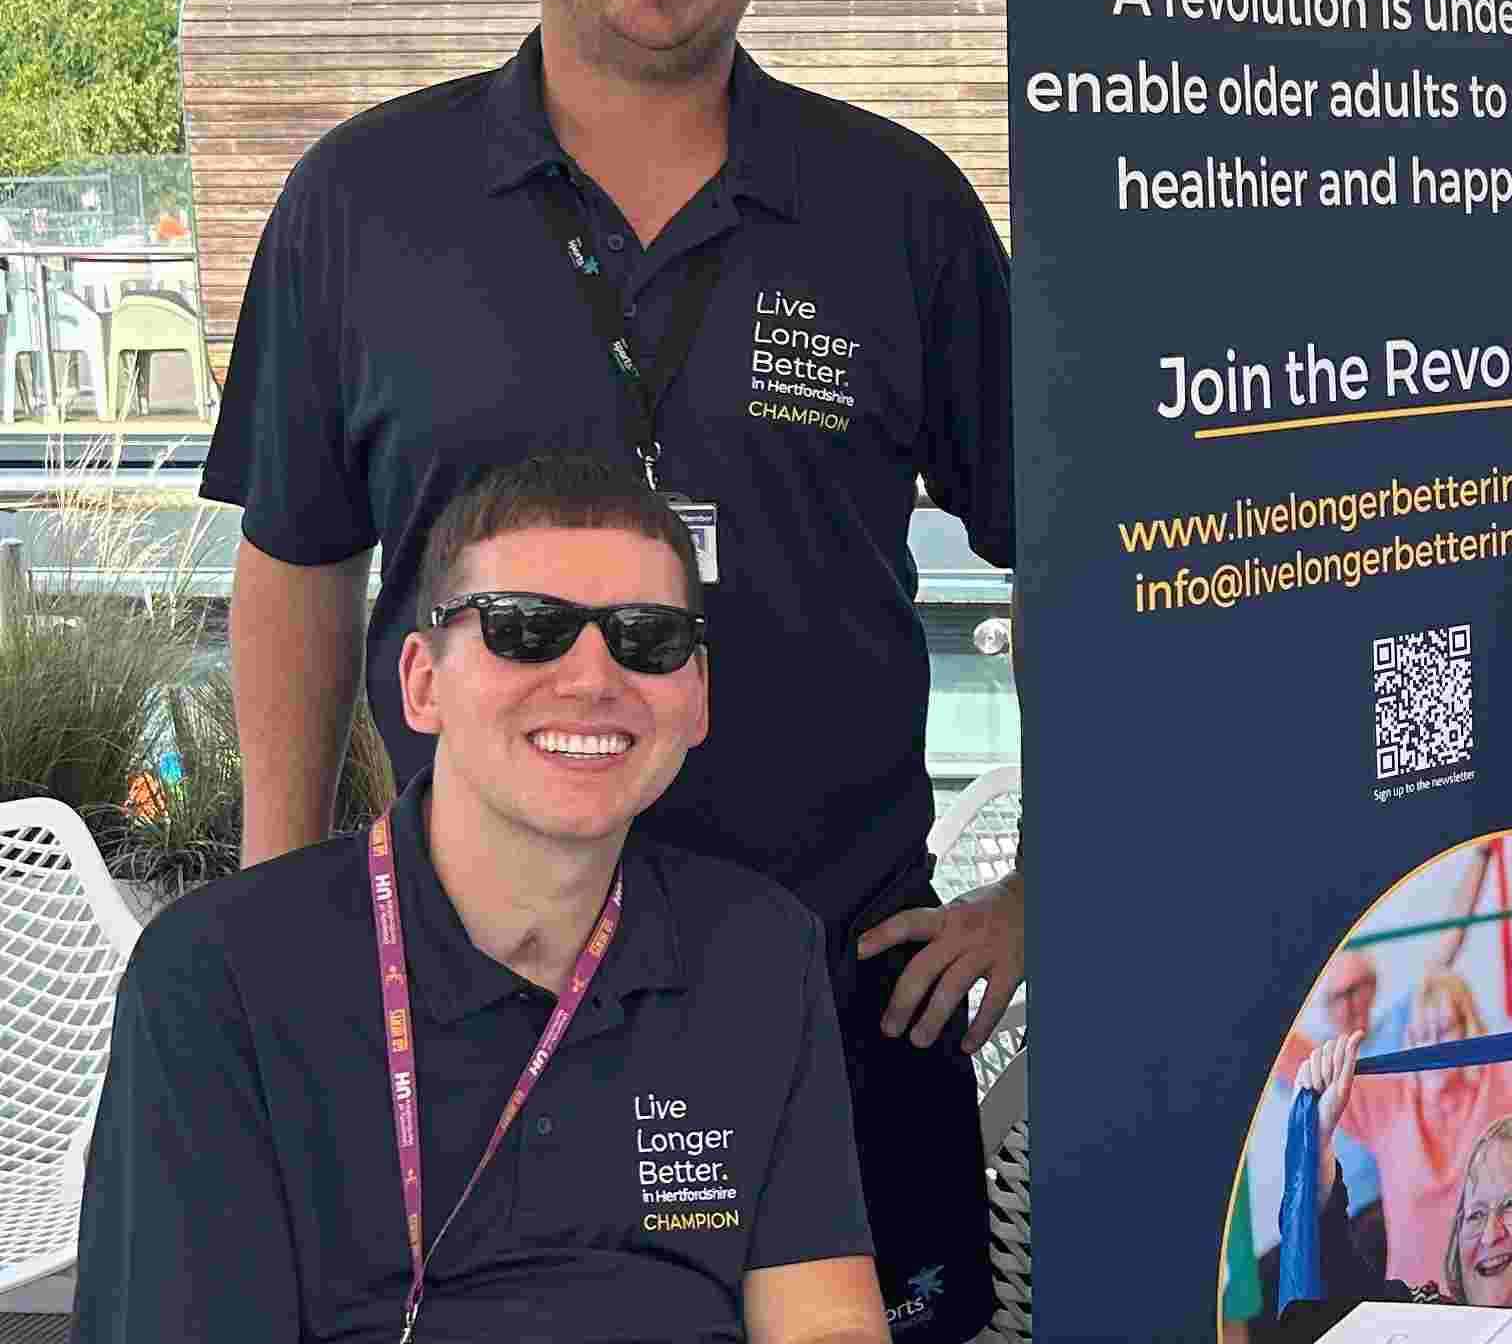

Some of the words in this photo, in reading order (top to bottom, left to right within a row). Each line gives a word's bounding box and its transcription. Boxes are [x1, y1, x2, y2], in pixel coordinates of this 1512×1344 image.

[1026, 60, 1208, 114] enable
[1218, 64, 1318, 118] older
[1329, 69, 1459, 120] adults
[1469, 74, 1507, 119] to
[1118, 155, 1308, 210] healthier
[1318, 155, 1397, 207] and
[756, 290, 817, 320] Live
[753, 320, 861, 358] Longer
[752, 349, 849, 388] Better.
[1157, 346, 1272, 420] Join
[1286, 342, 1368, 406] the
[751, 376, 765, 391] in
[767, 379, 856, 408] Hertfordshire
[748, 400, 849, 433] CHAMPION
[1373, 788, 1391, 803] Sign
[1392, 785, 1405, 800] up
[1405, 782, 1416, 793] to
[1416, 780, 1432, 792] the
[375, 872, 393, 902] UH
[394, 1071, 412, 1101] UH
[634, 1093, 688, 1121] Live
[636, 1128, 734, 1157] Longer
[638, 1159, 729, 1186] Better.
[642, 1188, 655, 1204] in
[656, 1185, 738, 1204] Hertfordshire
[643, 1208, 740, 1232] CHAMPION
